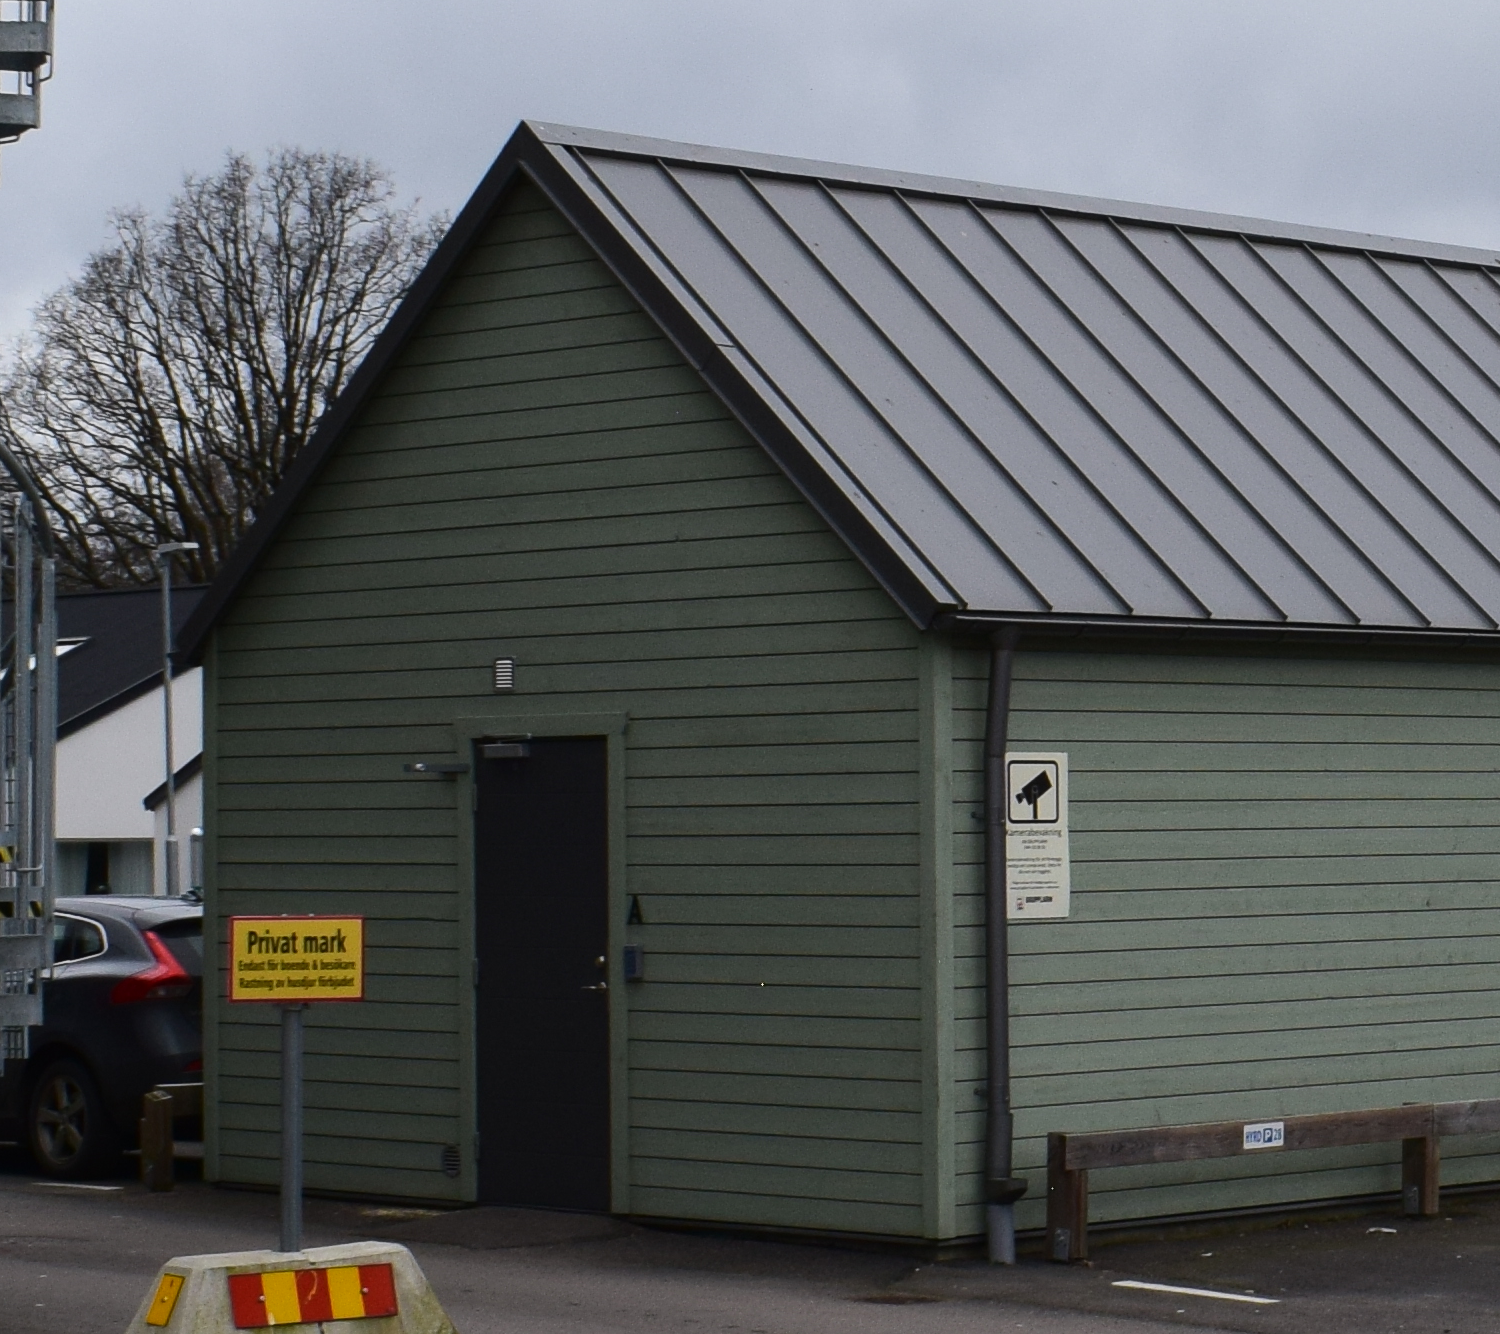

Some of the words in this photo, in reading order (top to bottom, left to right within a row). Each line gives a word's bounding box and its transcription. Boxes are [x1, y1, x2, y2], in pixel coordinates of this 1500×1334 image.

[627, 895, 644, 925] A
[247, 929, 298, 954] Privat
[303, 928, 347, 953] mark
